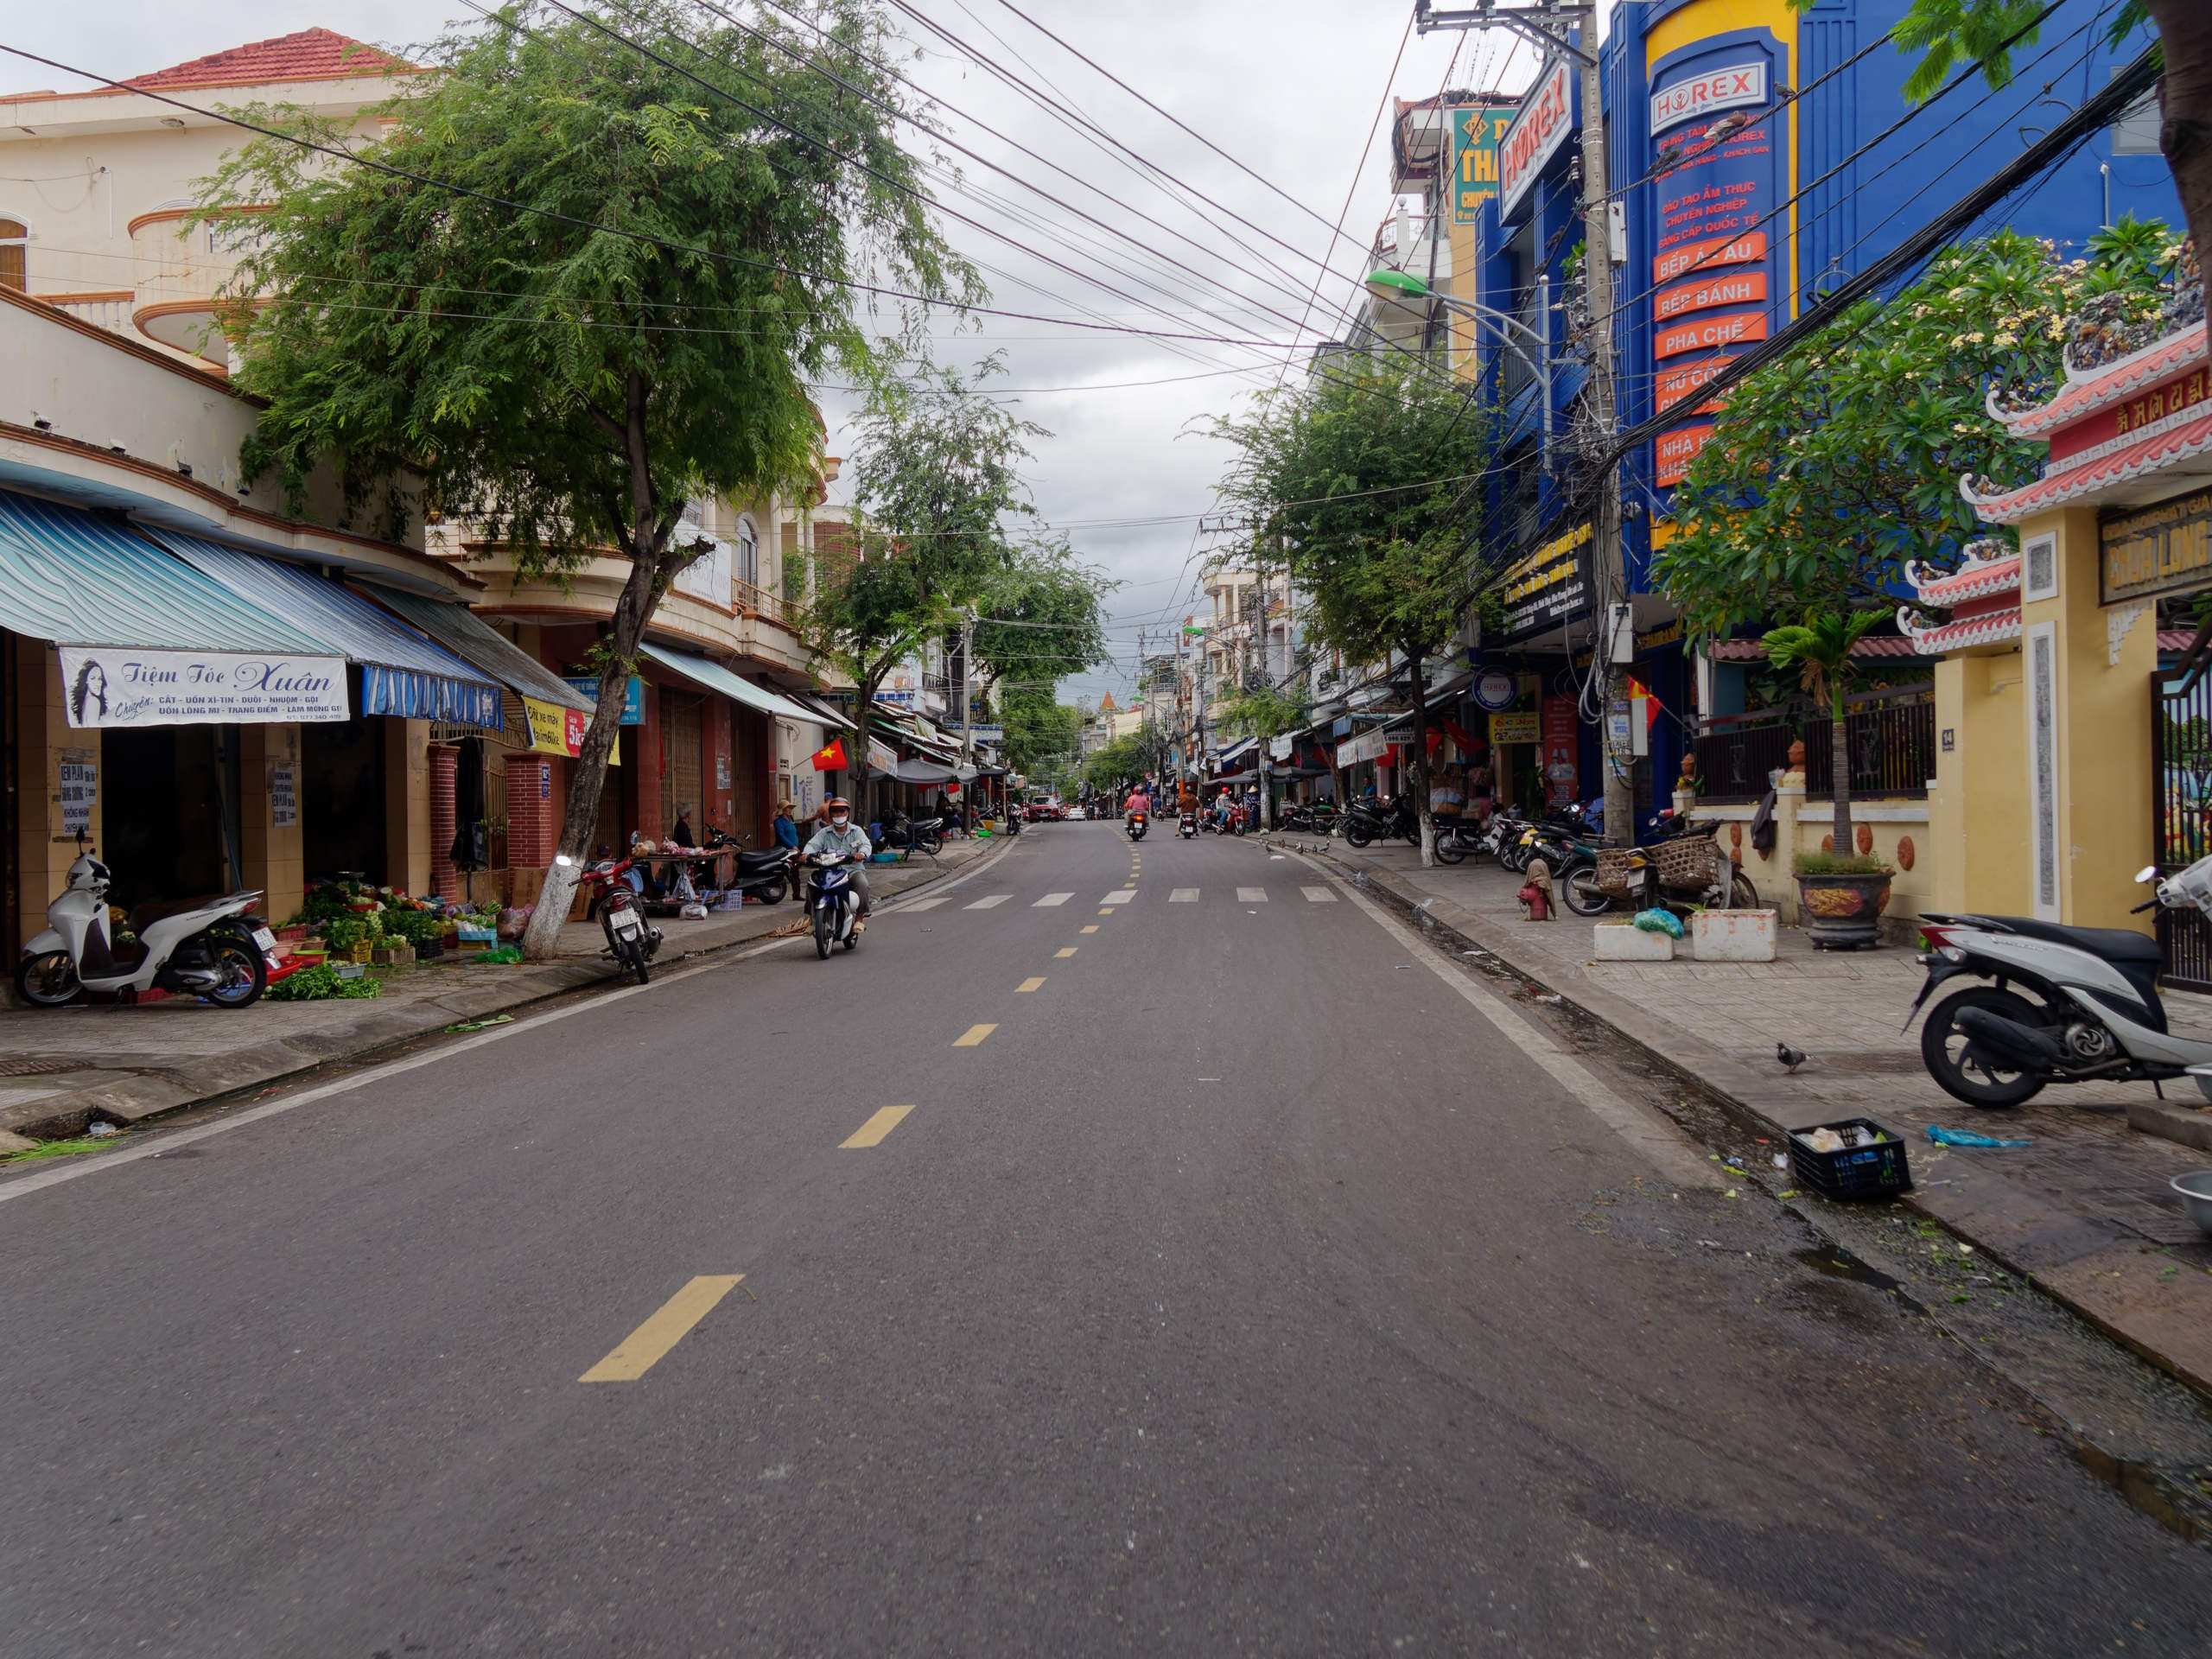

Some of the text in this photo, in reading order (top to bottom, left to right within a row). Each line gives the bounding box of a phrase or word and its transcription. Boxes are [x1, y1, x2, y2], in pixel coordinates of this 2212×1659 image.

[1658, 72, 1751, 119] HOREX
[1504, 68, 1565, 190] HOREX
[1724, 181, 1756, 194] THỰC
[1665, 197, 1748, 228] CHUYÊN NGHIỆP
[1705, 213, 1739, 233] QUỐC
[1660, 250, 1689, 277] BẾP
[1662, 282, 1751, 315] BẾP BÁNH
[1666, 315, 1745, 353] PHA CHẾ
[1662, 433, 1694, 459] NHÀ
[2158, 520, 2208, 576] LONG
[121, 661, 335, 692] Tiệm Tóc Xuân
